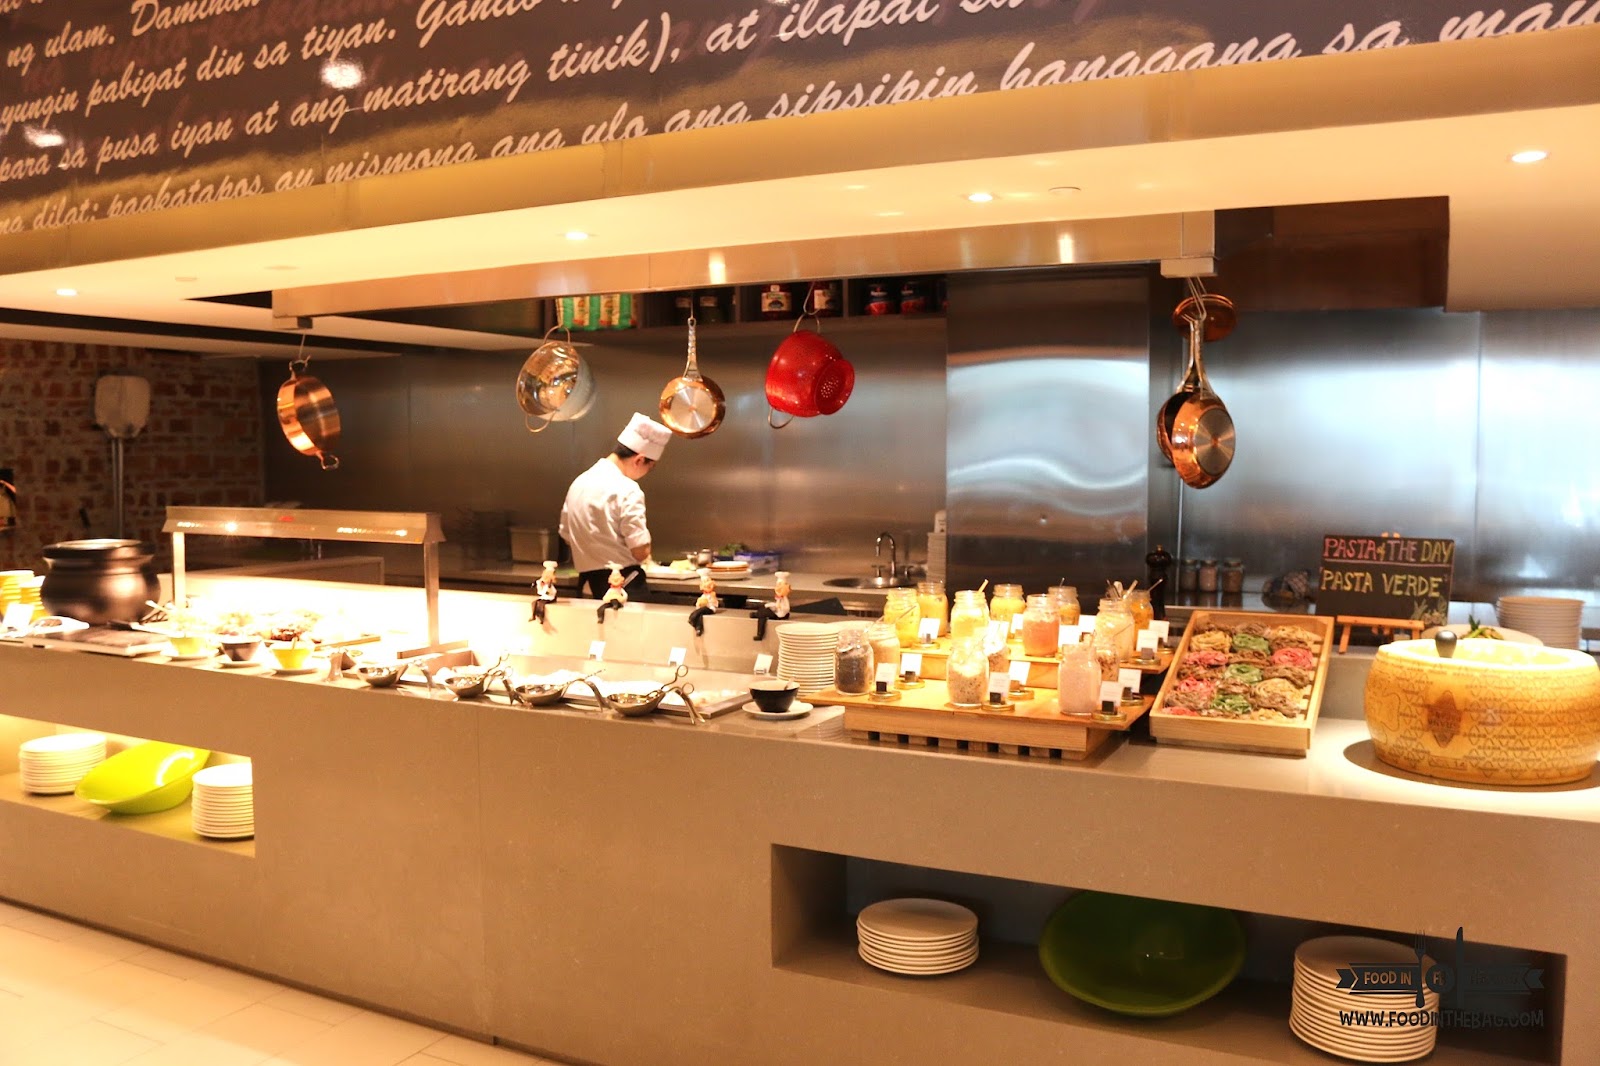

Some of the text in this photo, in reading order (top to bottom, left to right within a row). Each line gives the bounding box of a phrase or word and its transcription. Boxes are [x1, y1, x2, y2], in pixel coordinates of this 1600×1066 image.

[7, 42, 35, 76] ng
[44, 22, 115, 58] ulam.
[58, 147, 88, 171] sa
[95, 132, 160, 174] pusa
[170, 112, 234, 157] iyan
[245, 101, 279, 135] at
[290, 94, 348, 133] ang
[363, 60, 532, 112] matirang
[547, 12, 681, 82] tinik),
[705, 9, 759, 53] at
[86, 57, 188, 117] pabigat
[196, 45, 244, 81] din
[253, 44, 290, 70] sa
[301, 18, 396, 61] tiyan.
[581, 103, 648, 147] ulo
[1322, 20, 1409, 54] sa
[1323, 538, 1377, 560] PASTA
[1387, 540, 1417, 562] THE
[1421, 541, 1451, 563] DAY
